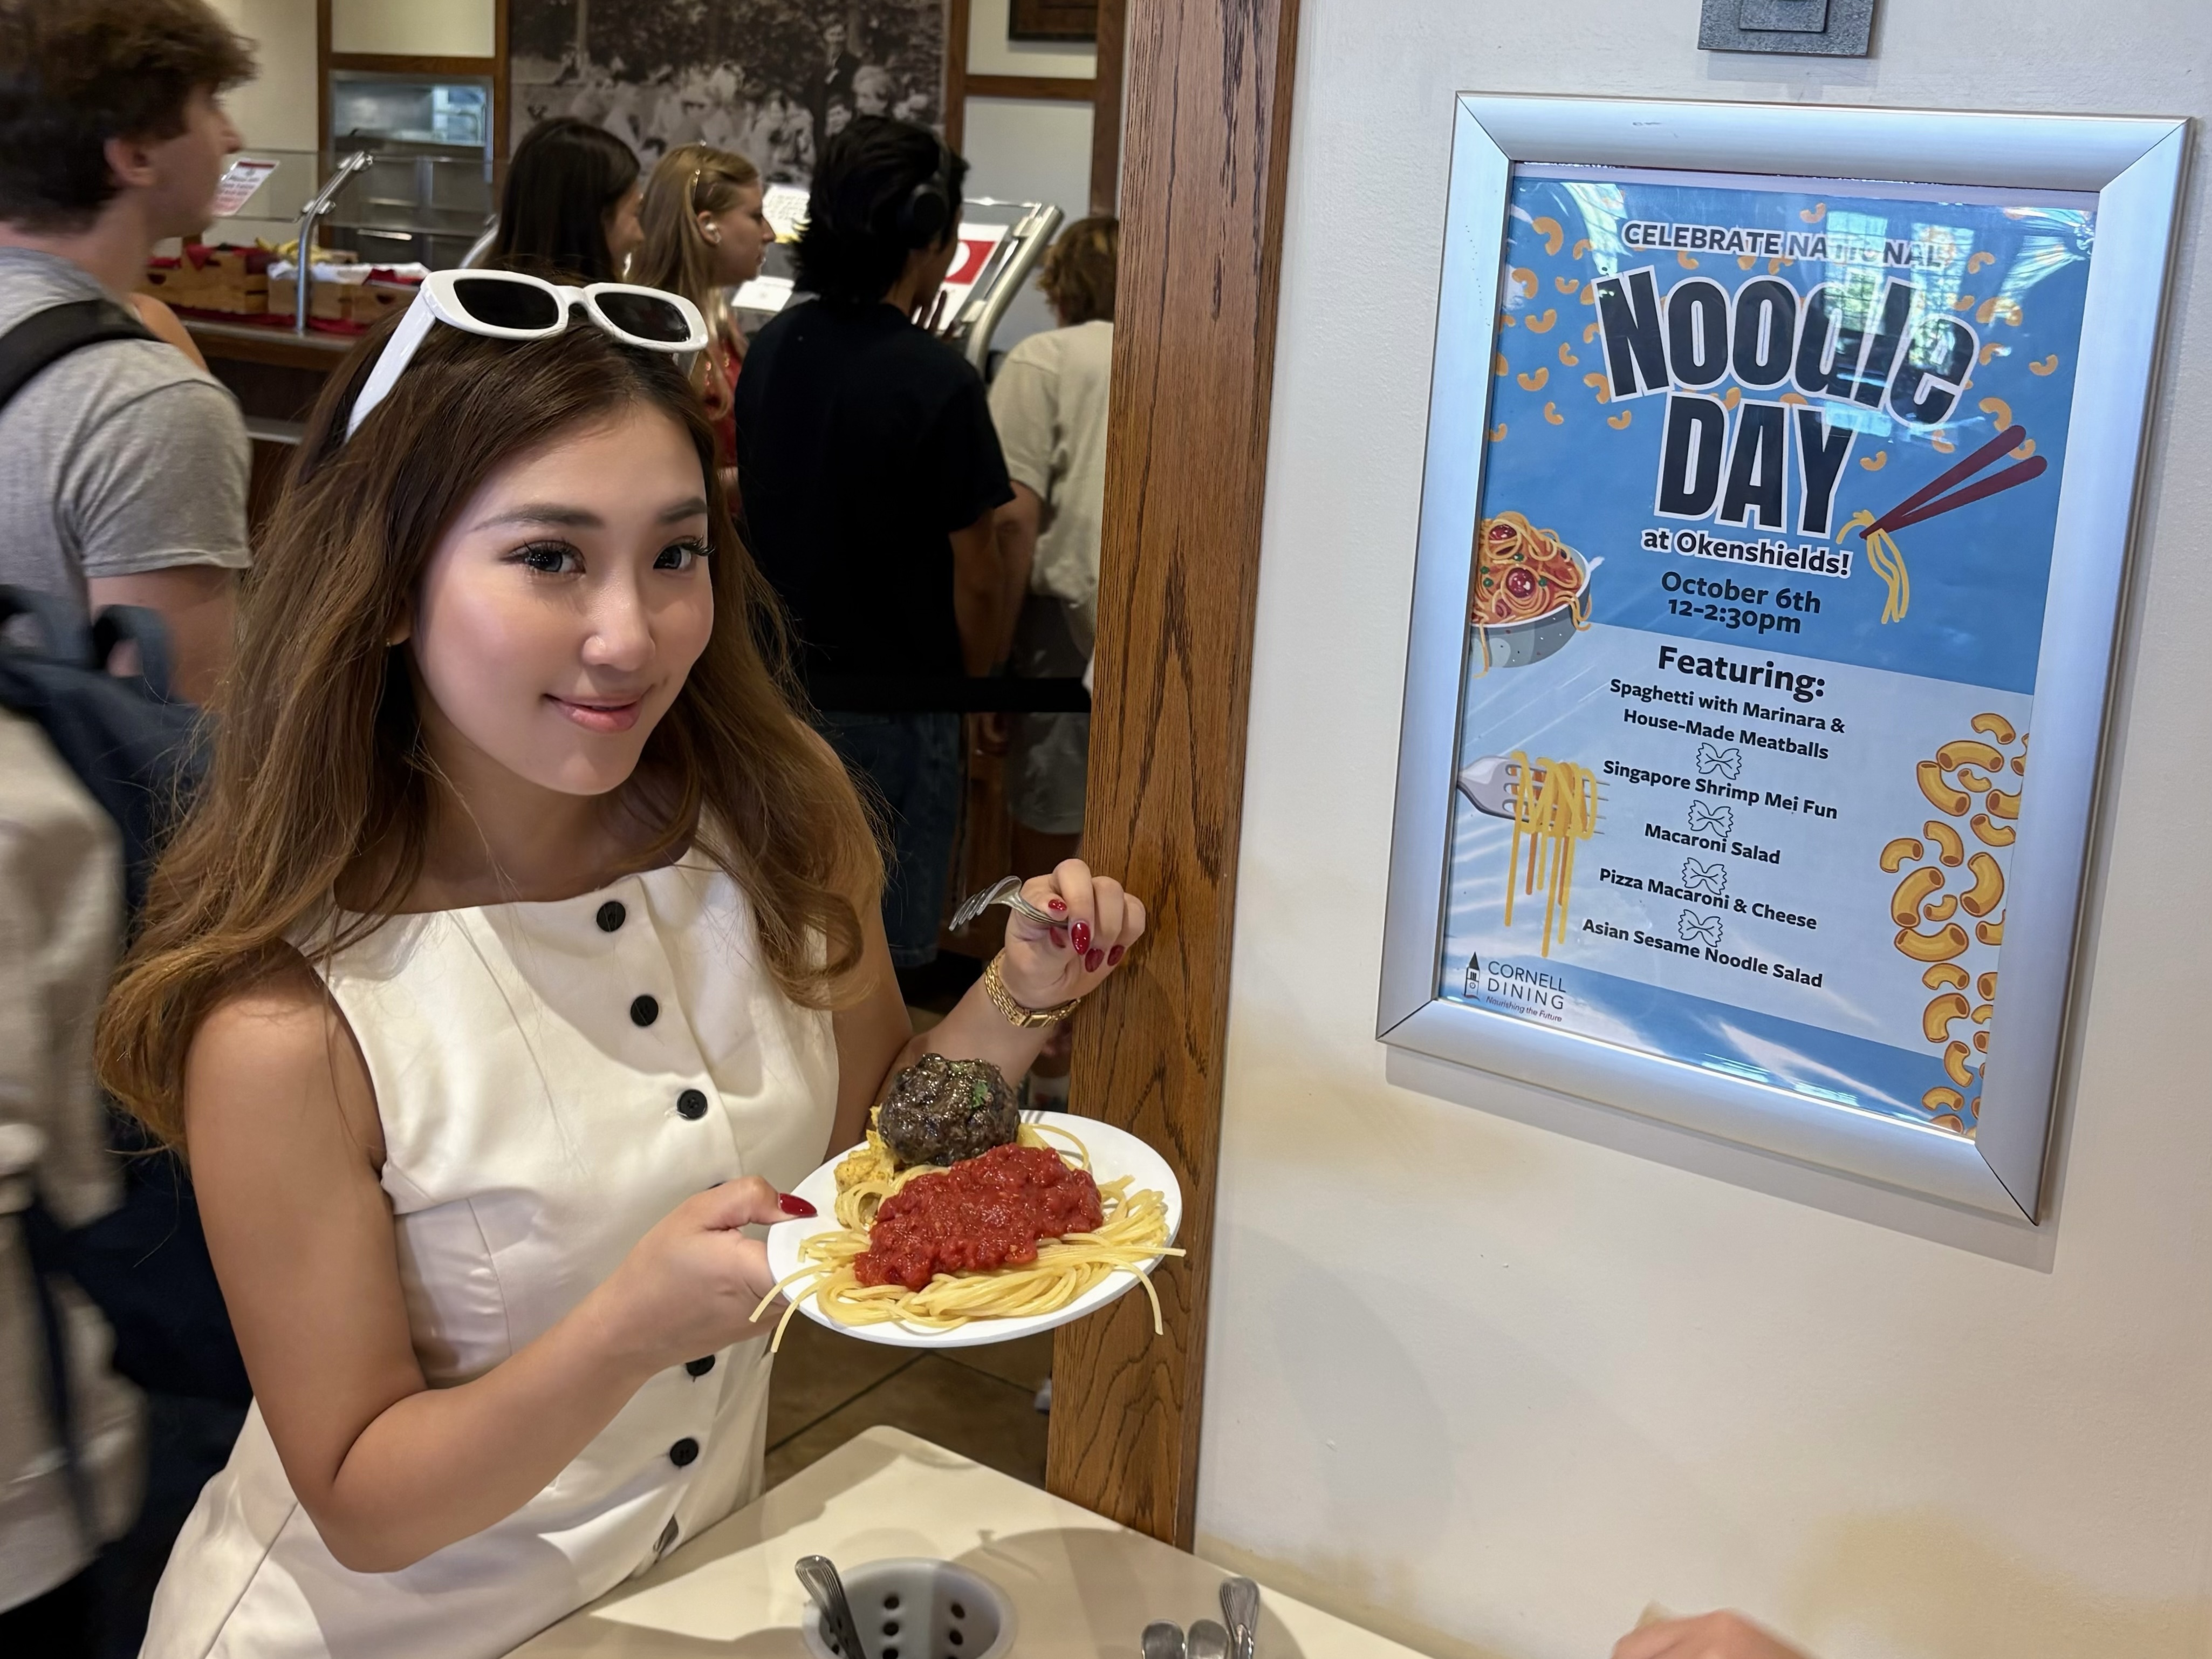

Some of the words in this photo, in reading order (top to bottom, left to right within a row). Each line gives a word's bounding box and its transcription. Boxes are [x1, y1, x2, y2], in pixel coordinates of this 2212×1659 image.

[1624, 222, 1782, 255] CELEBRATE
[1788, 233, 1943, 267] NATIONAL
[1657, 395, 1858, 535] DAY
[1643, 530, 1669, 550] at
[1676, 531, 1850, 576] Okenshields!
[1661, 571, 1769, 605] October
[1776, 588, 1821, 614] 6th
[1668, 599, 1801, 635] 12-2:30pm
[1658, 645, 1826, 703] Featuring:
[1610, 678, 1695, 706] Spaghetti
[1698, 695, 1738, 714] with
[1743, 701, 1826, 730] Marinara
[1830, 718, 1846, 734] &
[1623, 708, 1735, 742] House-Made
[1739, 729, 1829, 760] Meatballs
[1603, 760, 1691, 790] Singapore
[1694, 778, 1760, 806] Shrimp
[1764, 791, 1799, 811] Mei
[1803, 799, 1838, 820] Fun
[1644, 823, 1727, 854] Macaroni
[1730, 842, 1781, 865] Salad
[1599, 868, 1643, 891] Pizza
[1647, 878, 1730, 910] Macaroni
[1733, 898, 1748, 914] &
[1751, 902, 1818, 930] Cheese
[1582, 918, 1629, 941] Asian
[1633, 931, 1701, 959] Sesame
[1704, 946, 1769, 975] Noodle
[1772, 963, 1823, 988] Salad
[1487, 978, 1564, 1009] DINING
[1488, 961, 1566, 993] CORNELL
[1485, 995, 1525, 1014] Nourishing
[1525, 1006, 1538, 1016] the
[1539, 1010, 1563, 1022] Future
